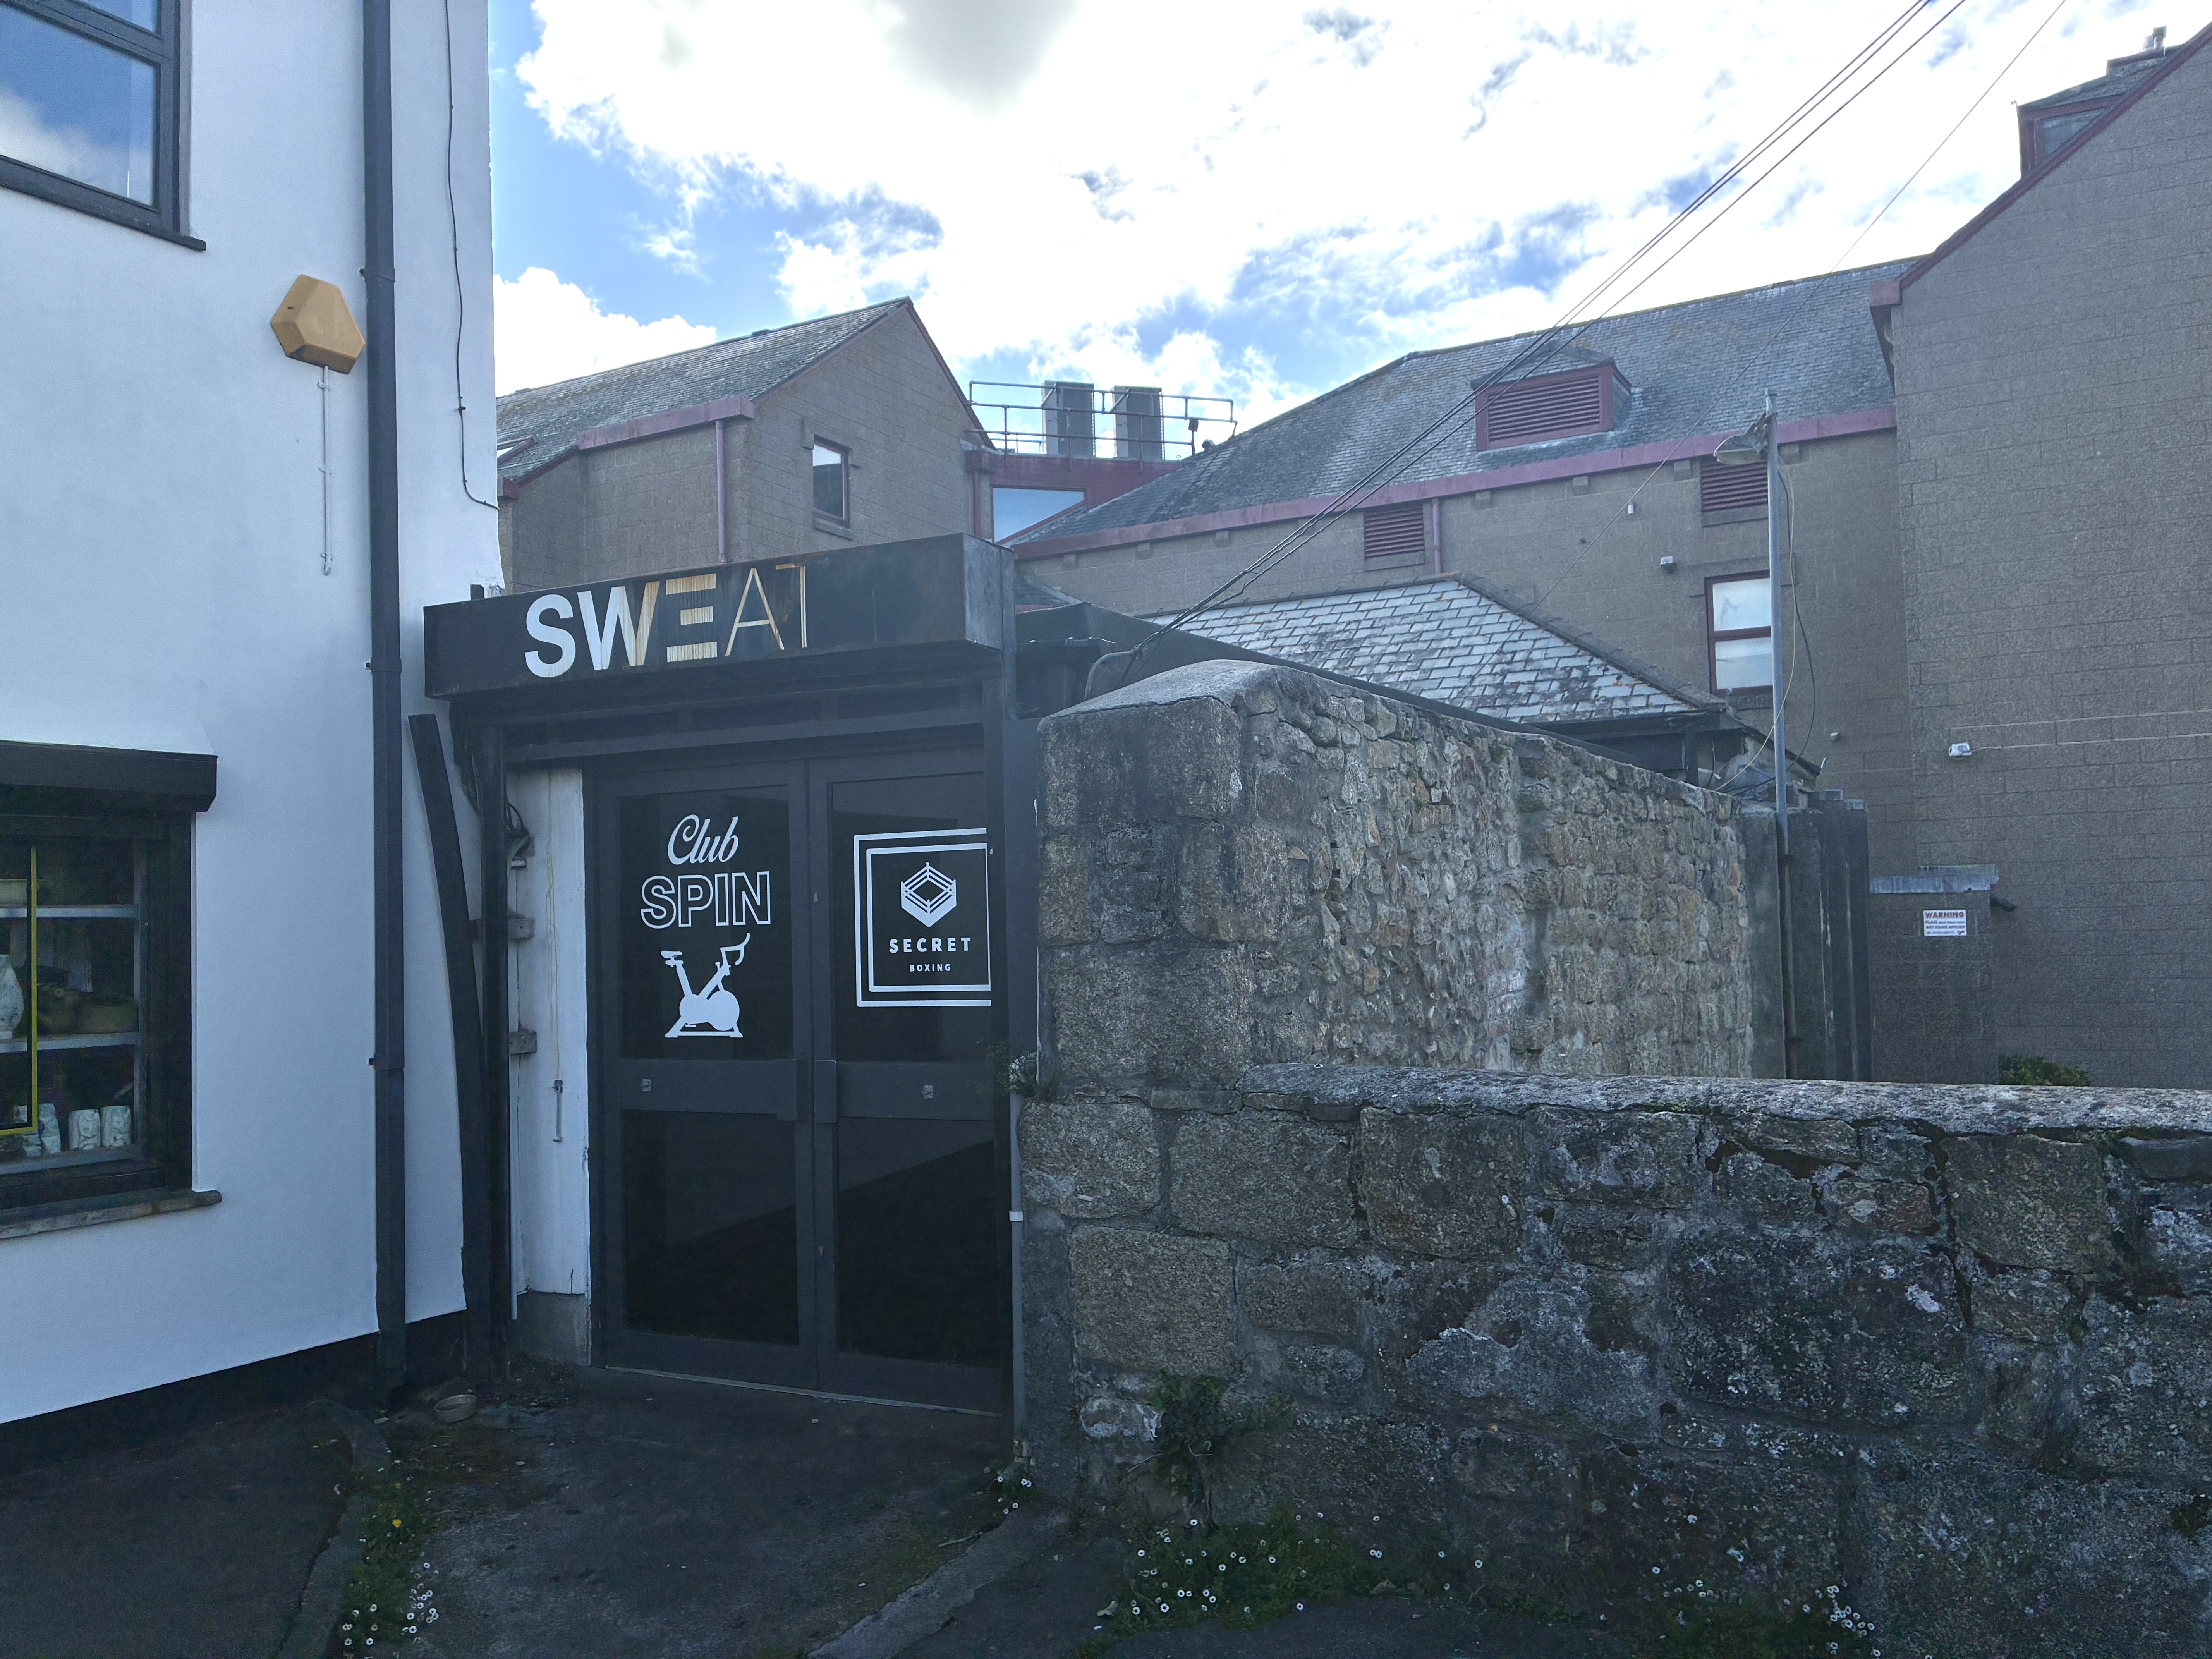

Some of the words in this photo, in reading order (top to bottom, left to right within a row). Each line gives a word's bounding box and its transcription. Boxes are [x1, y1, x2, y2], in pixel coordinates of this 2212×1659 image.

[524, 564, 807, 678] SWEAT
[667, 814, 739, 866] Club
[640, 871, 771, 929] SPIN
[888, 937, 972, 954] SECRET
[909, 963, 951, 972] BOXING
